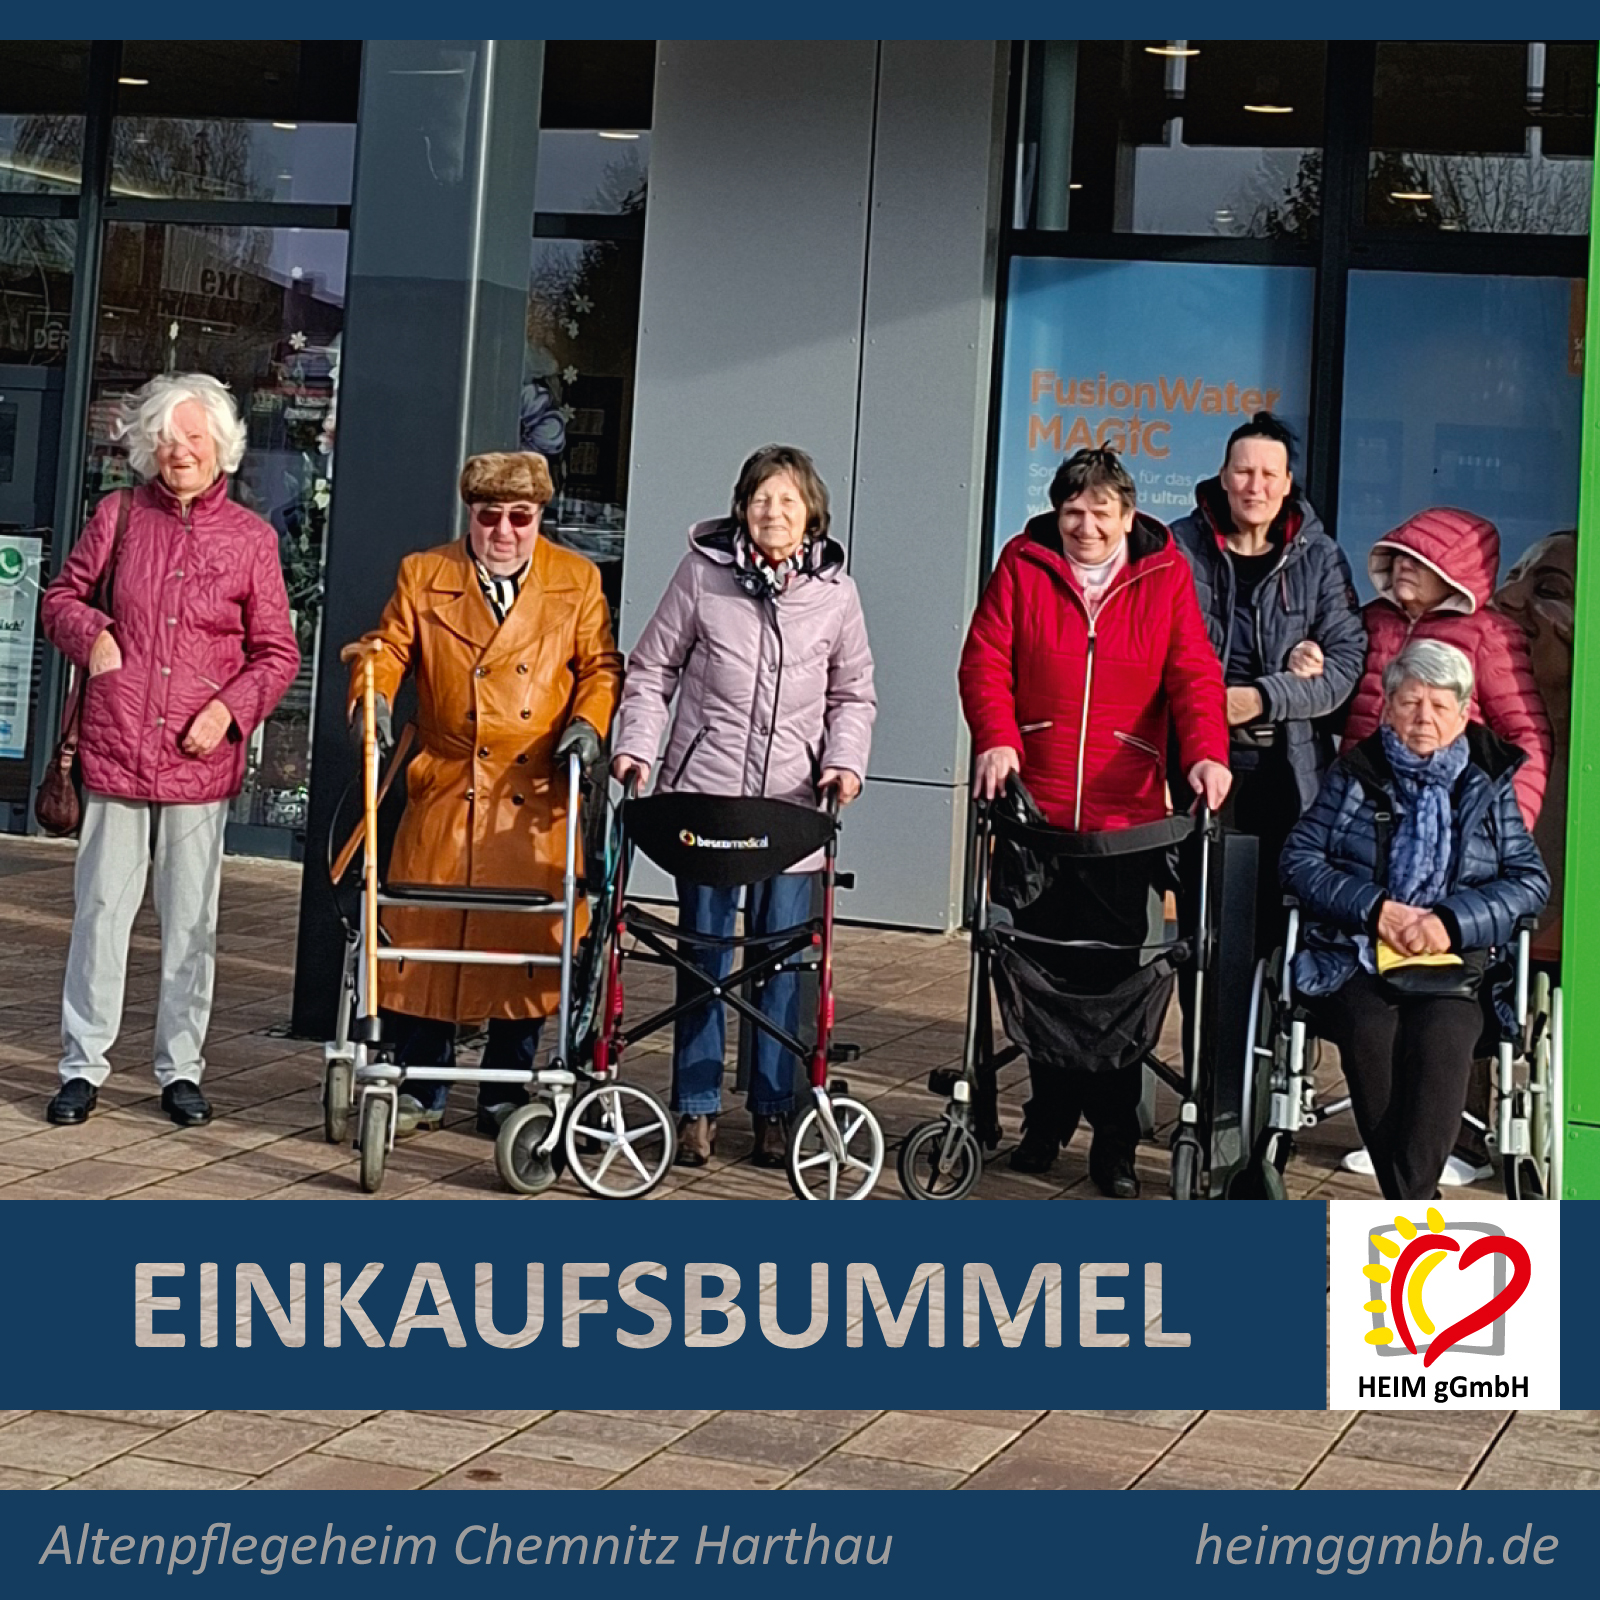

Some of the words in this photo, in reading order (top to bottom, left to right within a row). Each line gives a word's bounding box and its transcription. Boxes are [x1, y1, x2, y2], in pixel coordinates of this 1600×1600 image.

[1031, 368, 1281, 415] FusionWater
[1139, 469, 1160, 484] für
[1165, 473, 1191, 487] das
